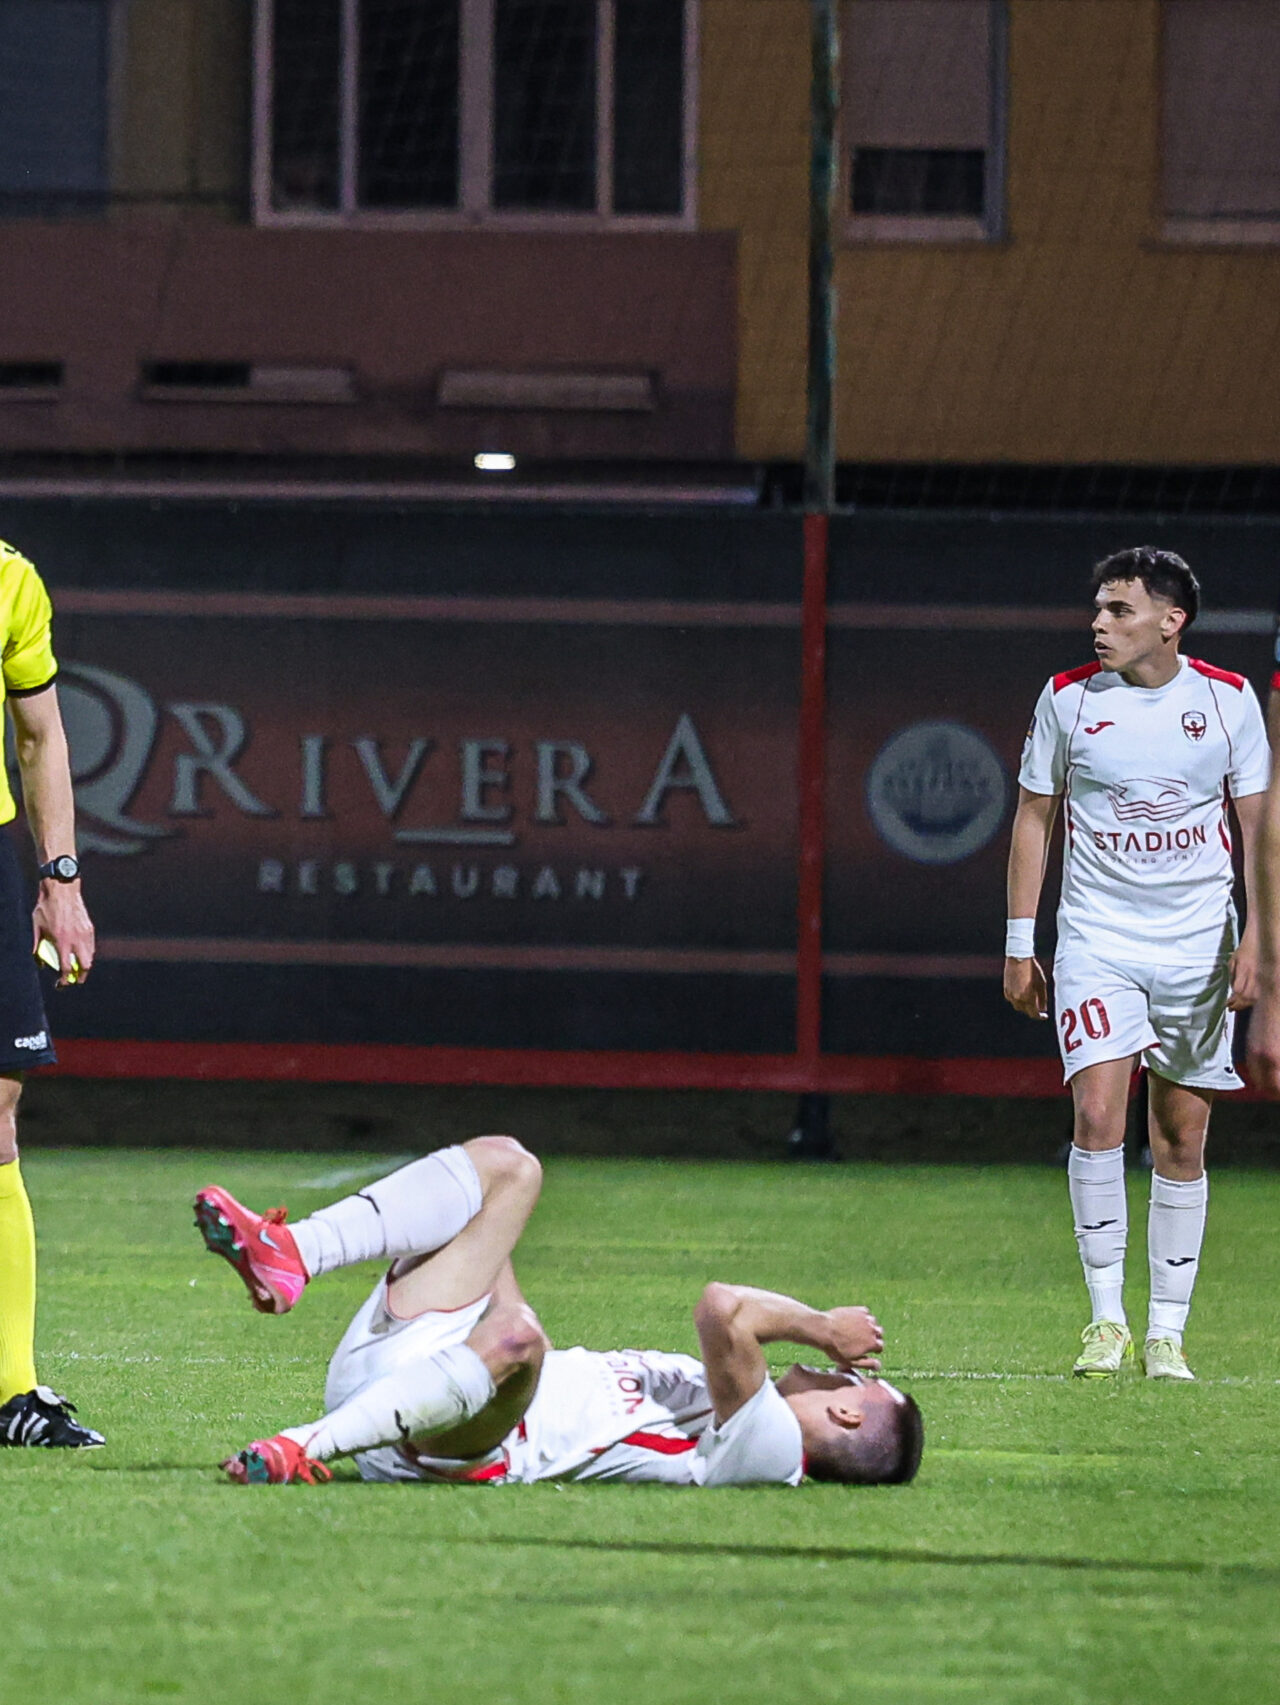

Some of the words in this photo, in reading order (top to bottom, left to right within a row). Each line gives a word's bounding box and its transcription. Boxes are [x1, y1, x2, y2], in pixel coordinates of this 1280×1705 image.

[1093, 825, 1207, 852] STADION
[258, 860, 644, 900] RESTAURANT
[1061, 998, 1111, 1054] 20
